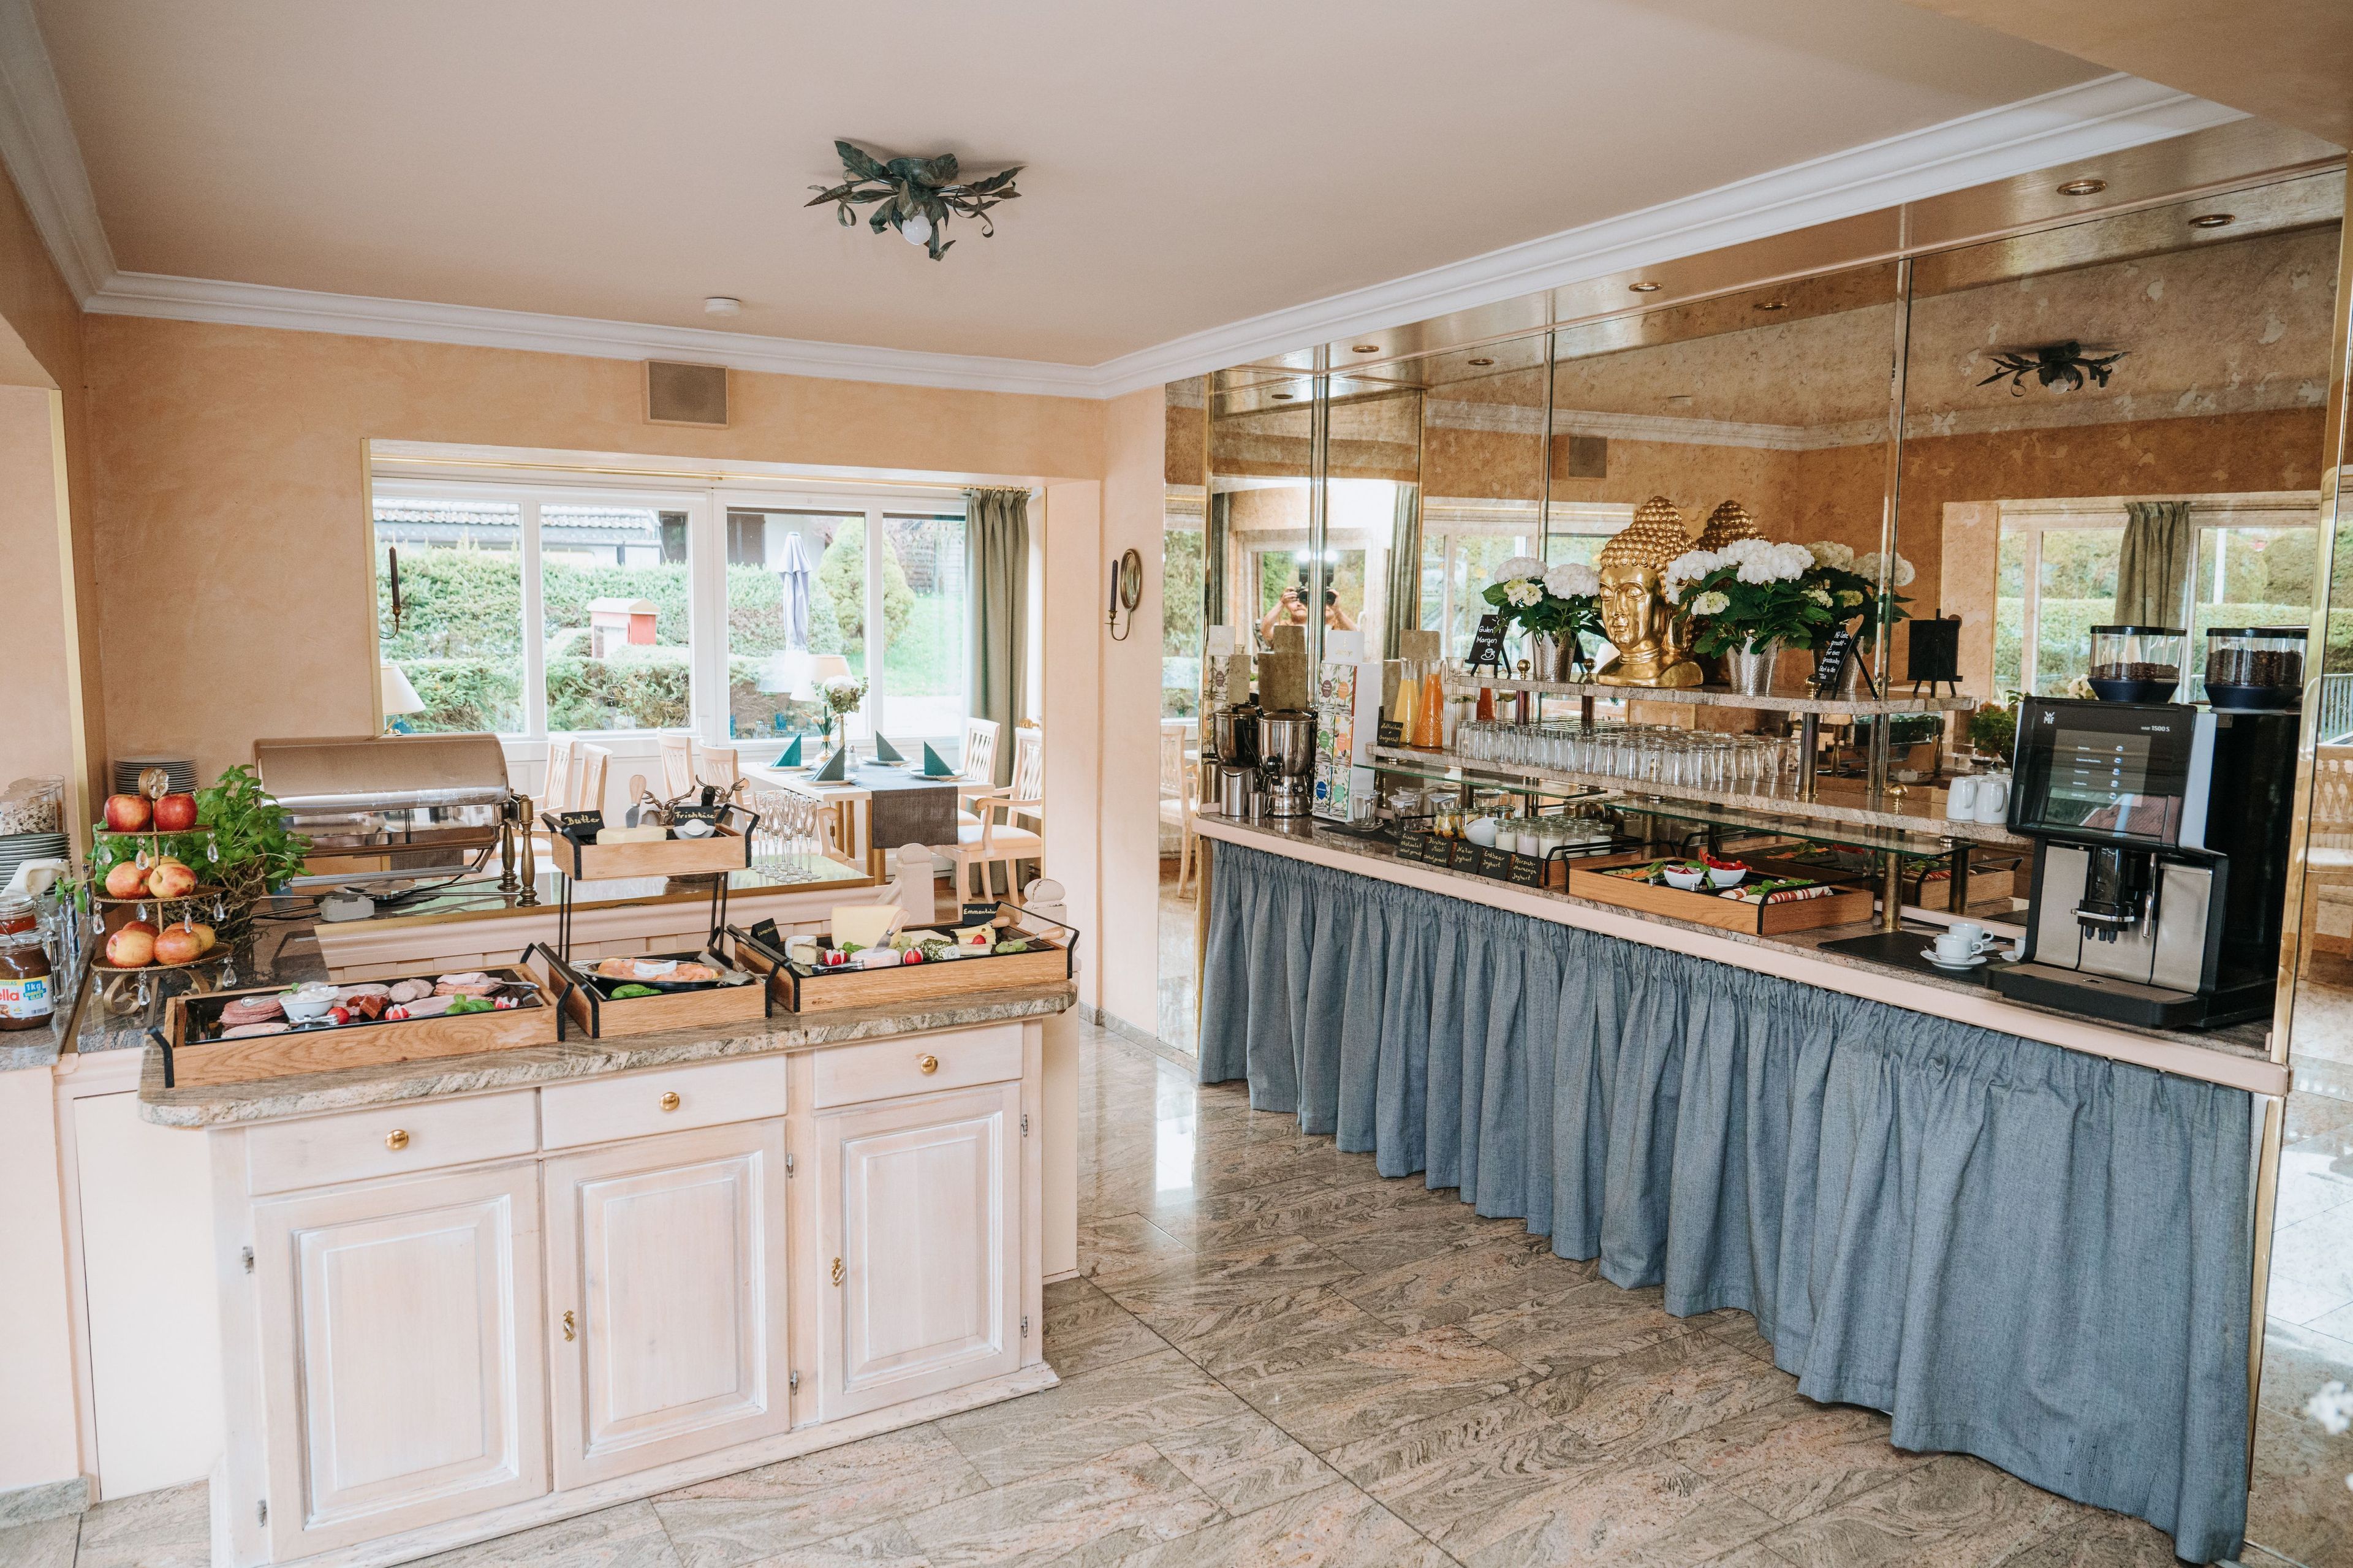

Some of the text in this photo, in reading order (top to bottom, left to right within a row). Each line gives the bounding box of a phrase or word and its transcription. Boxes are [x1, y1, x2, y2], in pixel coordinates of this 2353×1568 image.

[1476, 636, 1497, 646] Morgen
[564, 814, 600, 826] Butter
[1457, 846, 1473, 854] Natur
[1454, 855, 1472, 863] Joghurt
[1484, 850, 1505, 861] Erdbeer
[1482, 859, 1501, 869] Joghurt
[1513, 866, 1537, 874] Maracuja
